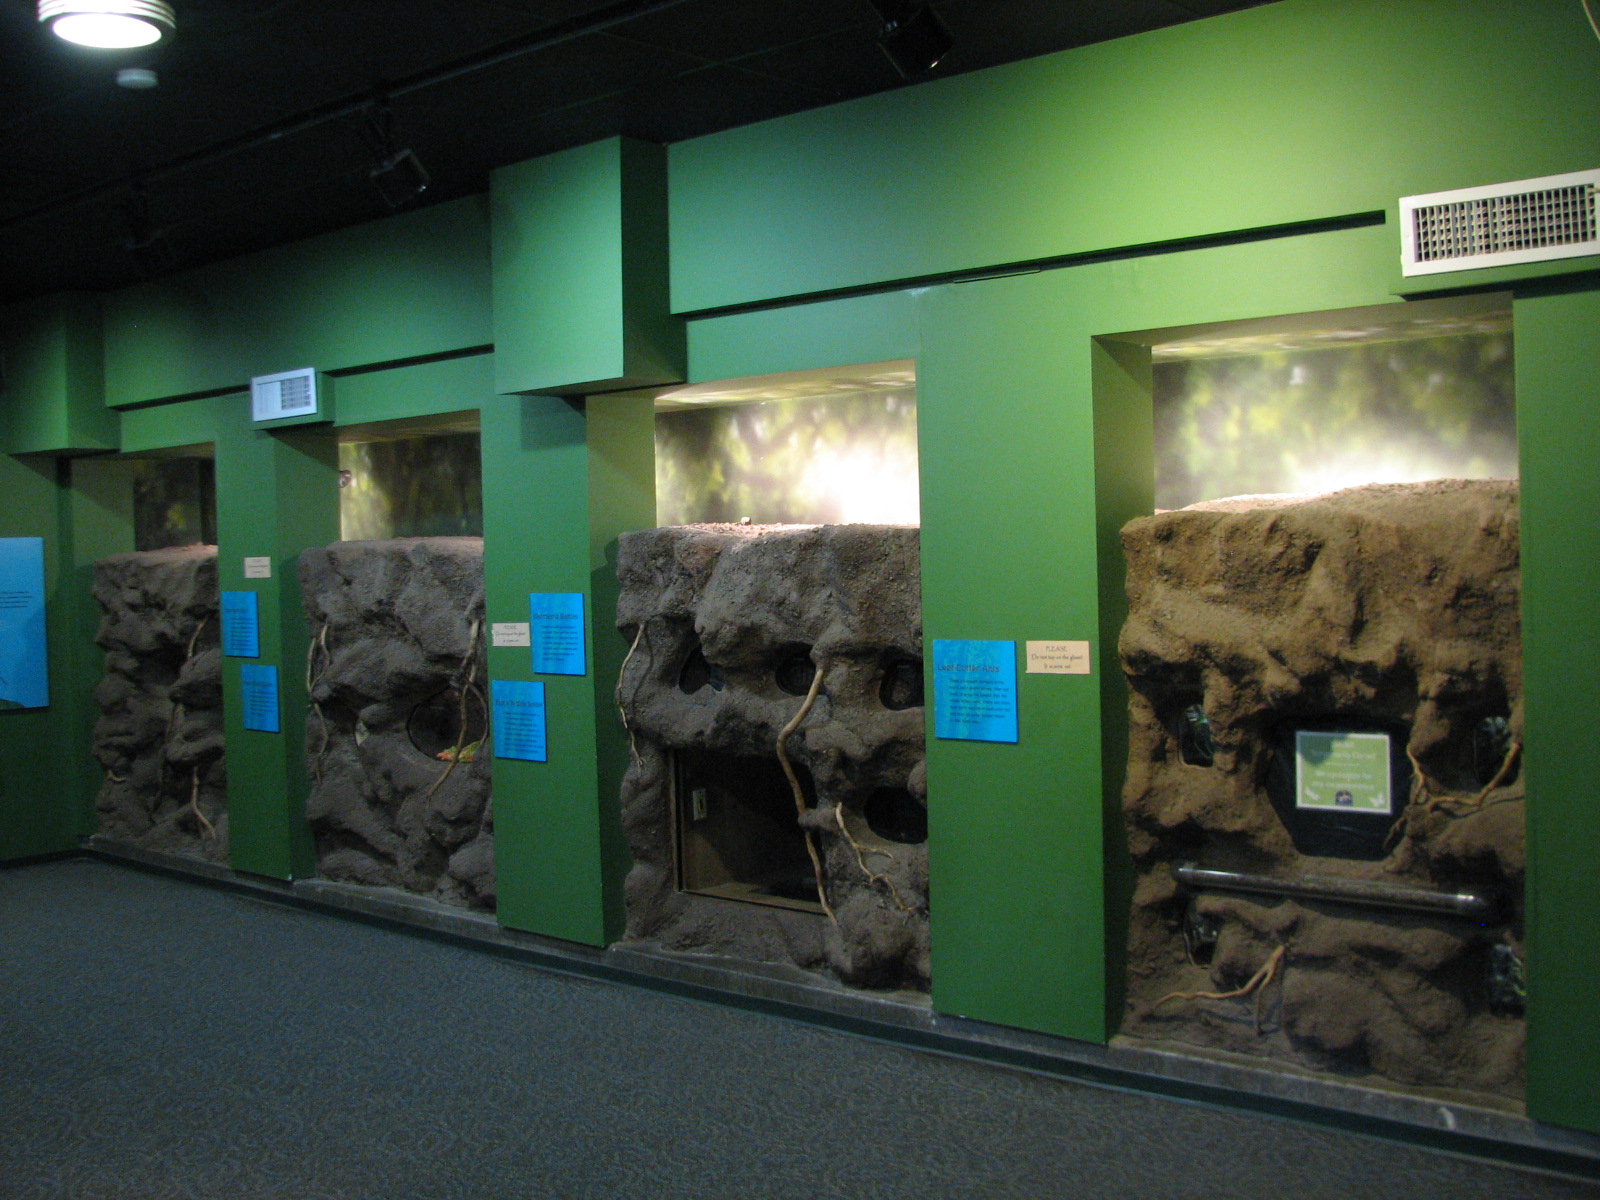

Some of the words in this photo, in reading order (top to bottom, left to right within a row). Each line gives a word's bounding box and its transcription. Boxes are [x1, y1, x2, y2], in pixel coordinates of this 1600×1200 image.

[937, 663, 954, 672] Leaf
[956, 663, 980, 673] Cutter
[982, 664, 1000, 673] Ants
